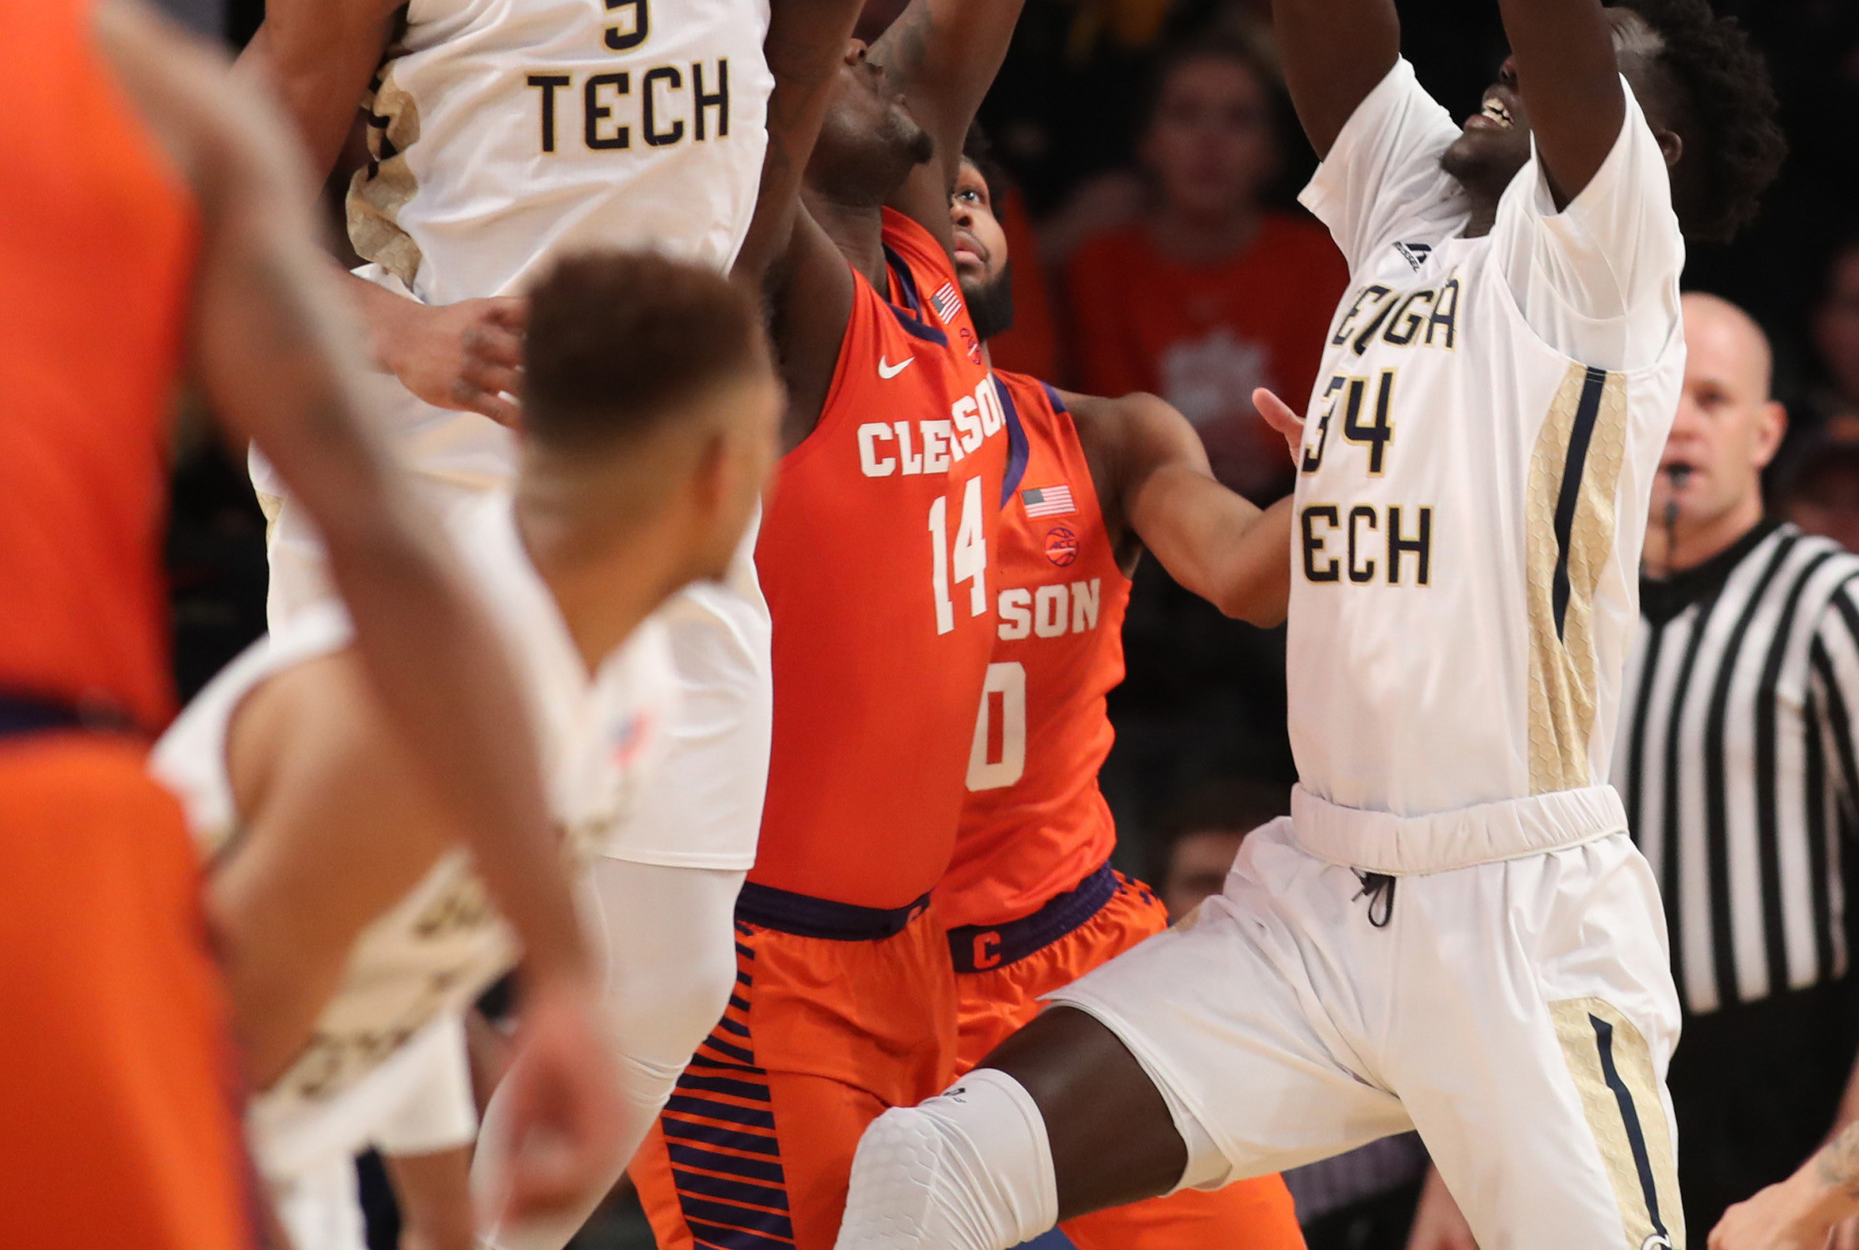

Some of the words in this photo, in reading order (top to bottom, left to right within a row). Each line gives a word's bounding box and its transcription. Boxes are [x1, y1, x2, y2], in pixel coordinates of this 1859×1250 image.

[525, 58, 731, 153] TECH
[857, 370, 1007, 478] CLESO
[929, 475, 988, 636] 14
[998, 577, 1101, 641] SON
[973, 931, 1003, 969] C
